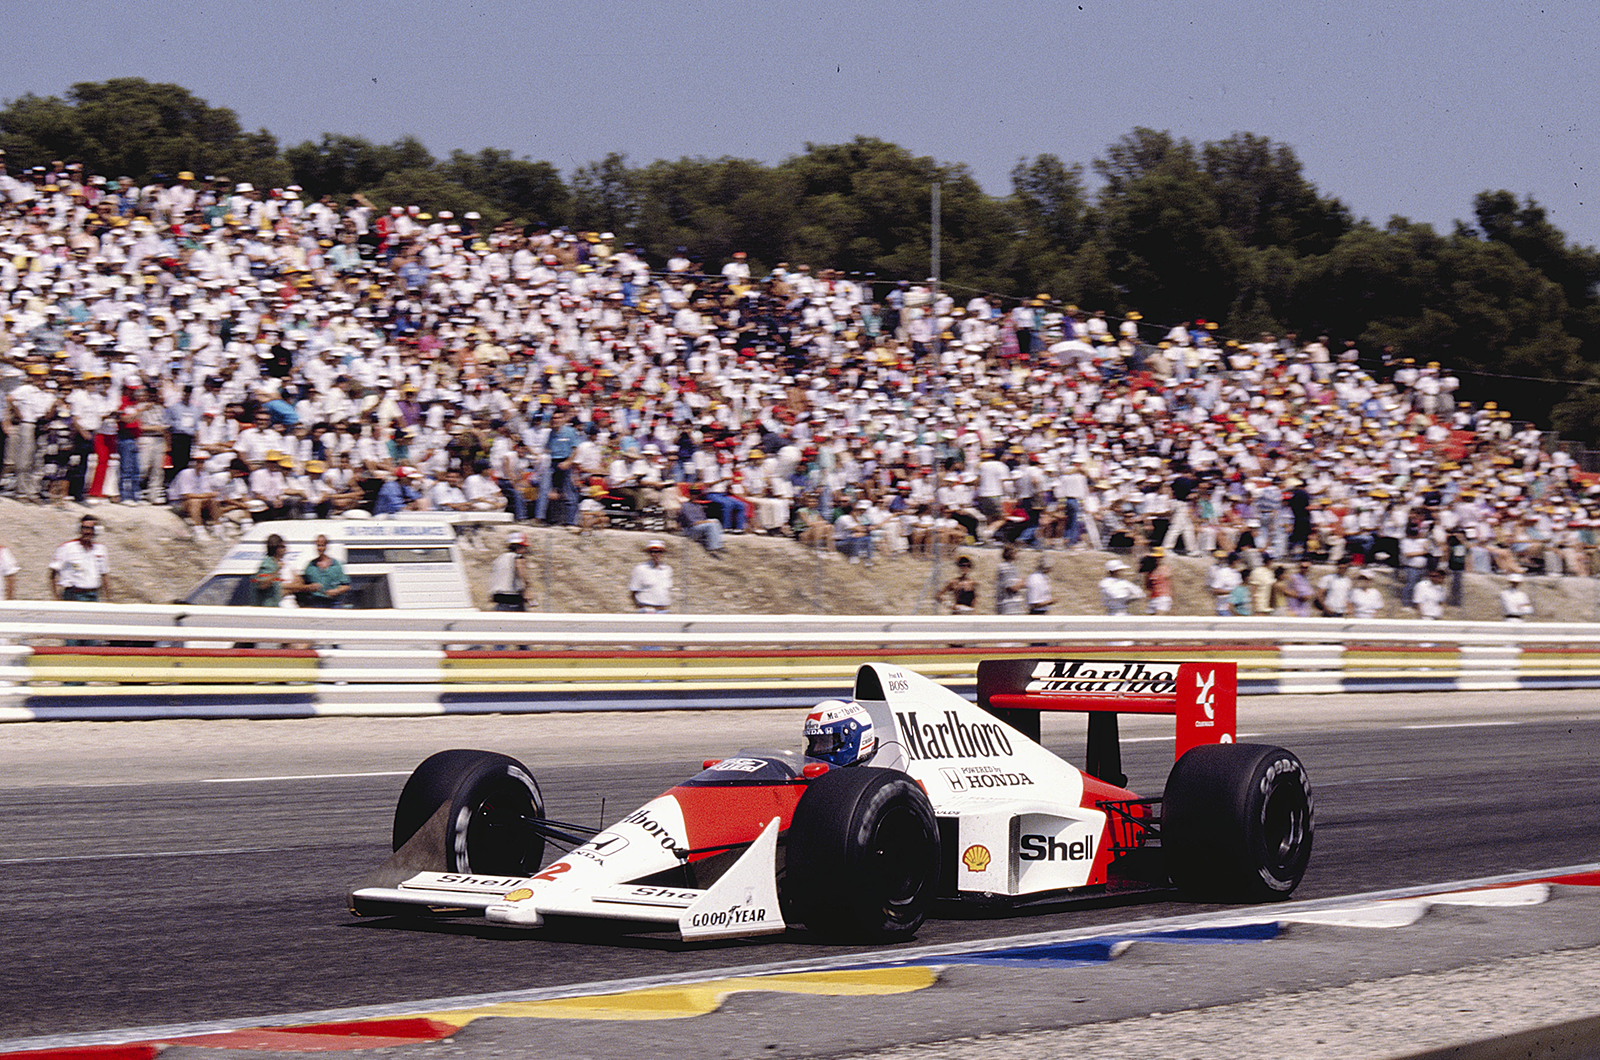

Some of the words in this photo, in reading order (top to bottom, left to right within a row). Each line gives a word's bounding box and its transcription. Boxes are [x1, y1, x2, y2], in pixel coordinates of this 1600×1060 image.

[888, 680, 909, 691] BOSS
[895, 710, 1013, 761] Marlboro
[961, 766, 993, 774] POWERED
[966, 772, 1035, 789] HONDA
[622, 809, 677, 850] lboro
[1019, 833, 1093, 861] Shell
[436, 874, 522, 887] Shell
[531, 862, 572, 882] 2
[631, 887, 698, 900] She
